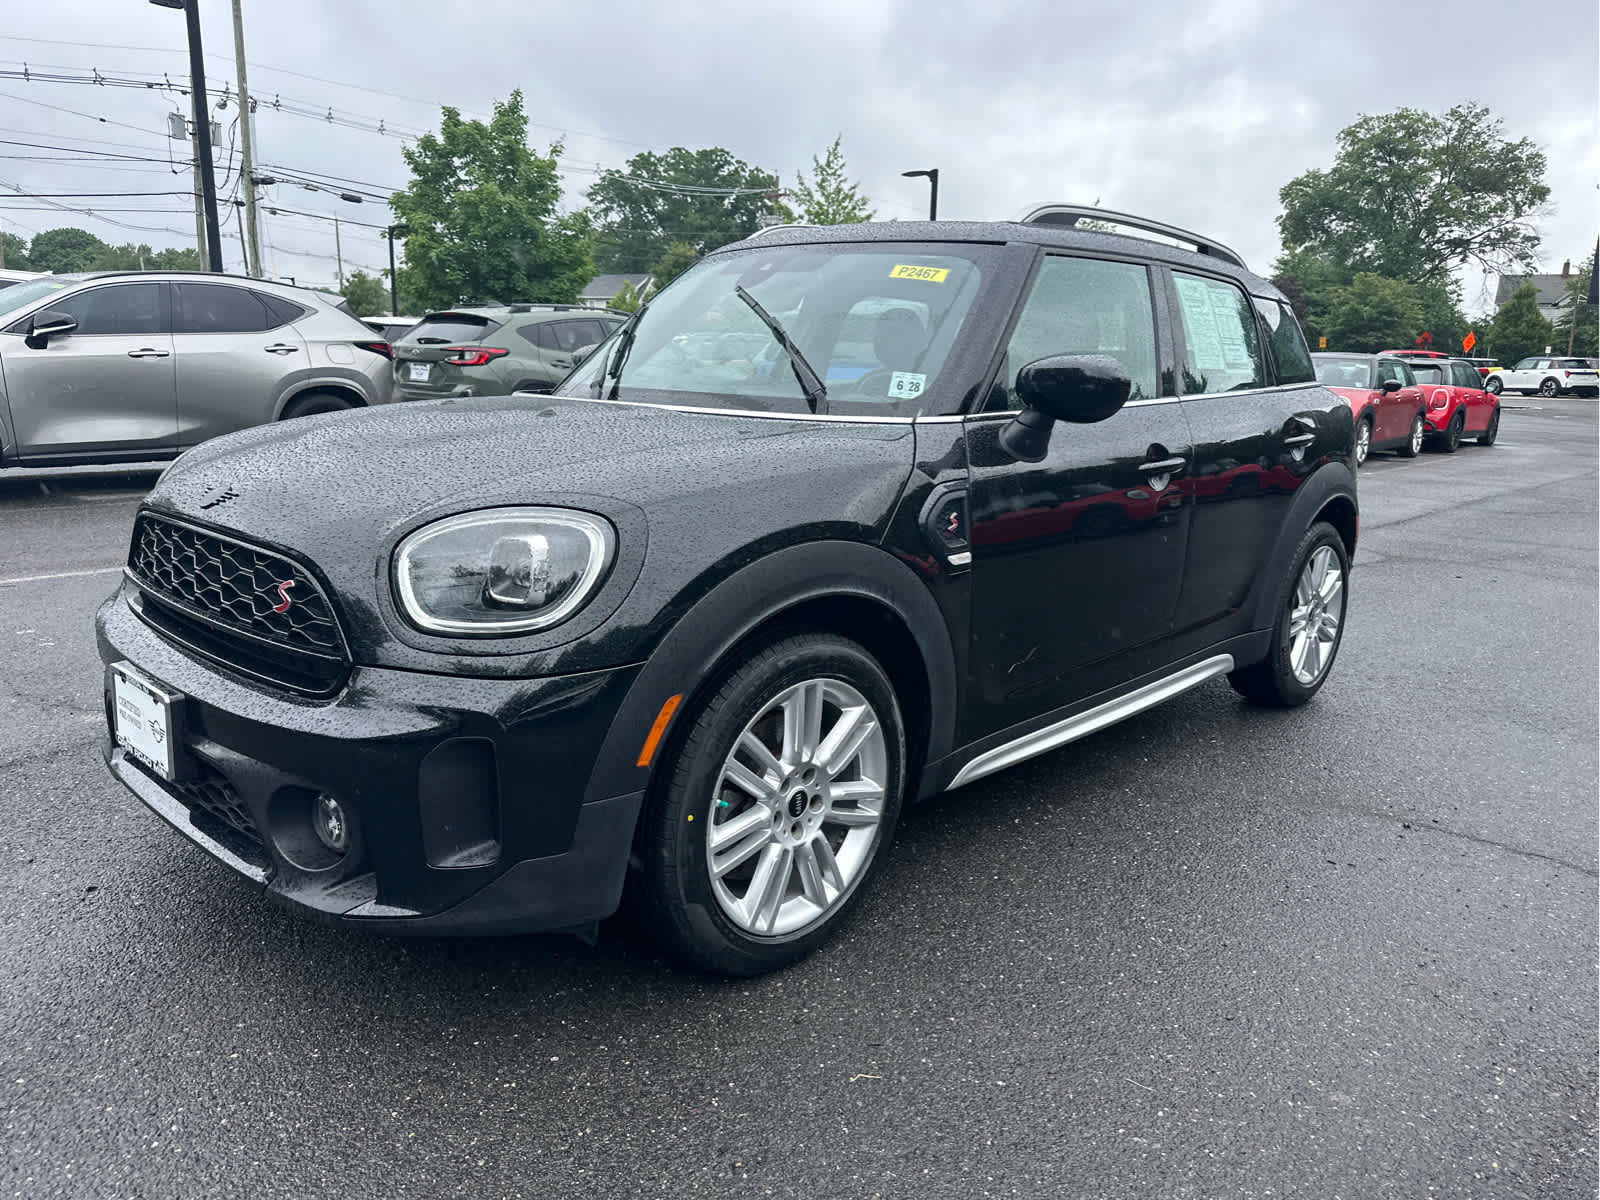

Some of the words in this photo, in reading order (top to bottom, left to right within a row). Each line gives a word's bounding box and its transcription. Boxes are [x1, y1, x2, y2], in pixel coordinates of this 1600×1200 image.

[897, 266, 941, 279] P2467
[896, 380, 904, 391] 6
[908, 381, 921, 393] 28
[272, 579, 296, 614] S
